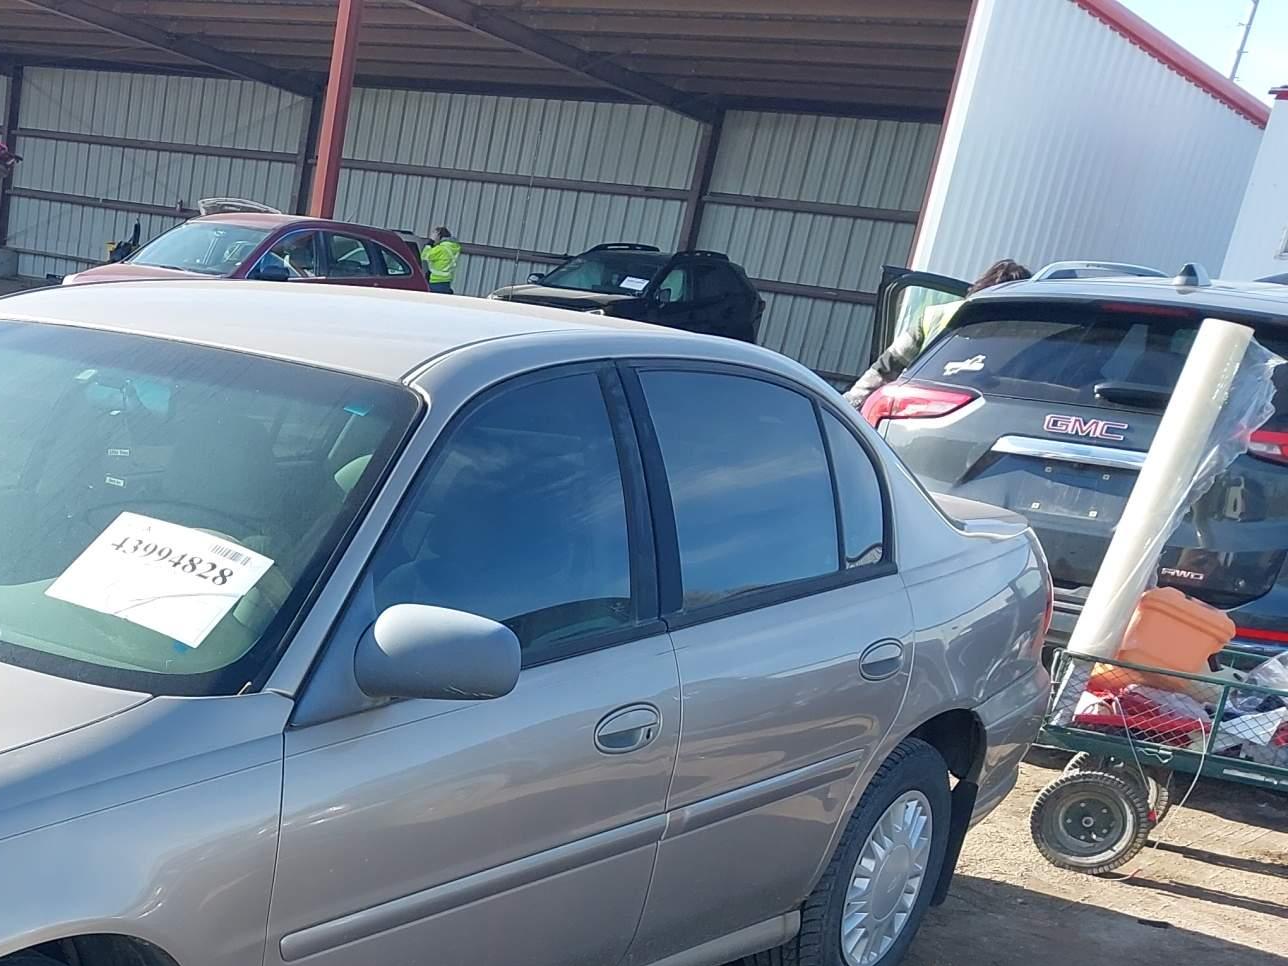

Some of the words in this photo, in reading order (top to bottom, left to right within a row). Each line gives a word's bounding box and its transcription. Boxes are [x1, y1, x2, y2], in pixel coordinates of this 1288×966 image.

[1043, 414, 1129, 441] GMC
[111, 536, 234, 586] 43994828
[1161, 567, 1205, 581] AWD
